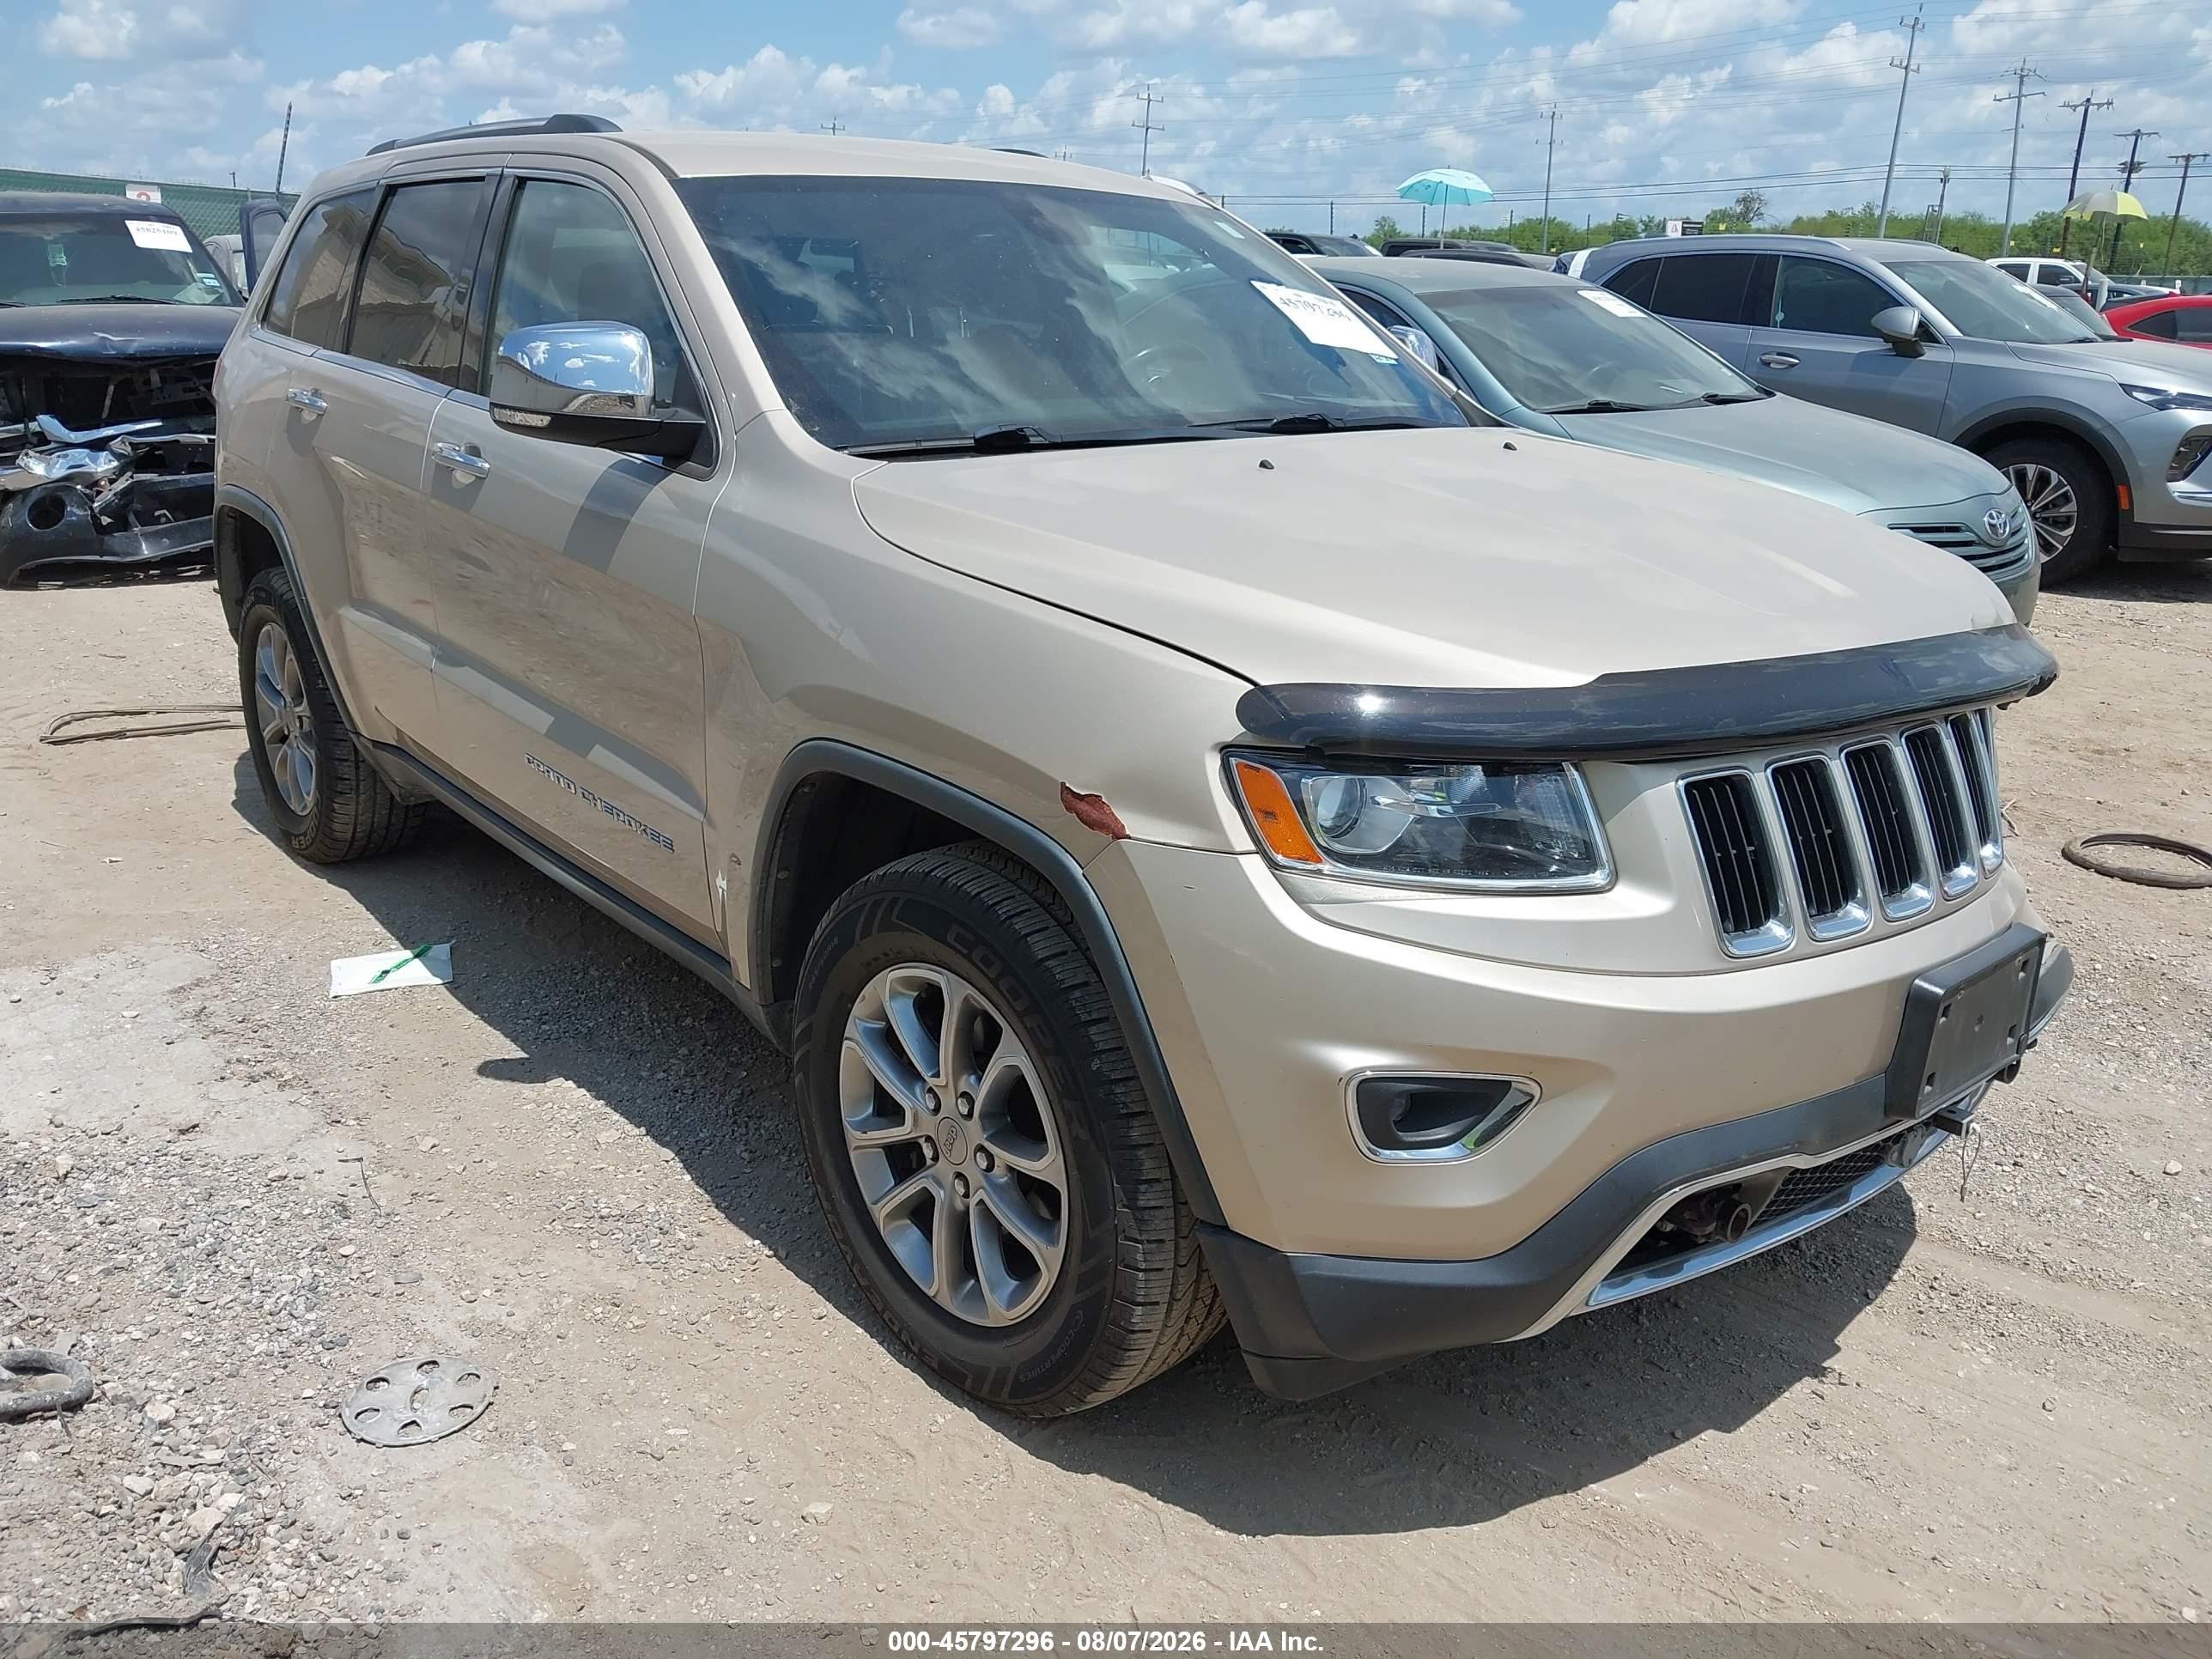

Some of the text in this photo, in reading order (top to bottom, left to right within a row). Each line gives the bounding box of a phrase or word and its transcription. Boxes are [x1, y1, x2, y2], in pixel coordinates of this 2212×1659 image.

[525, 752, 675, 854] GRAND CHEROKEE
[946, 923, 1091, 1140] COOPER
[943, 1124, 958, 1158] Jeep
